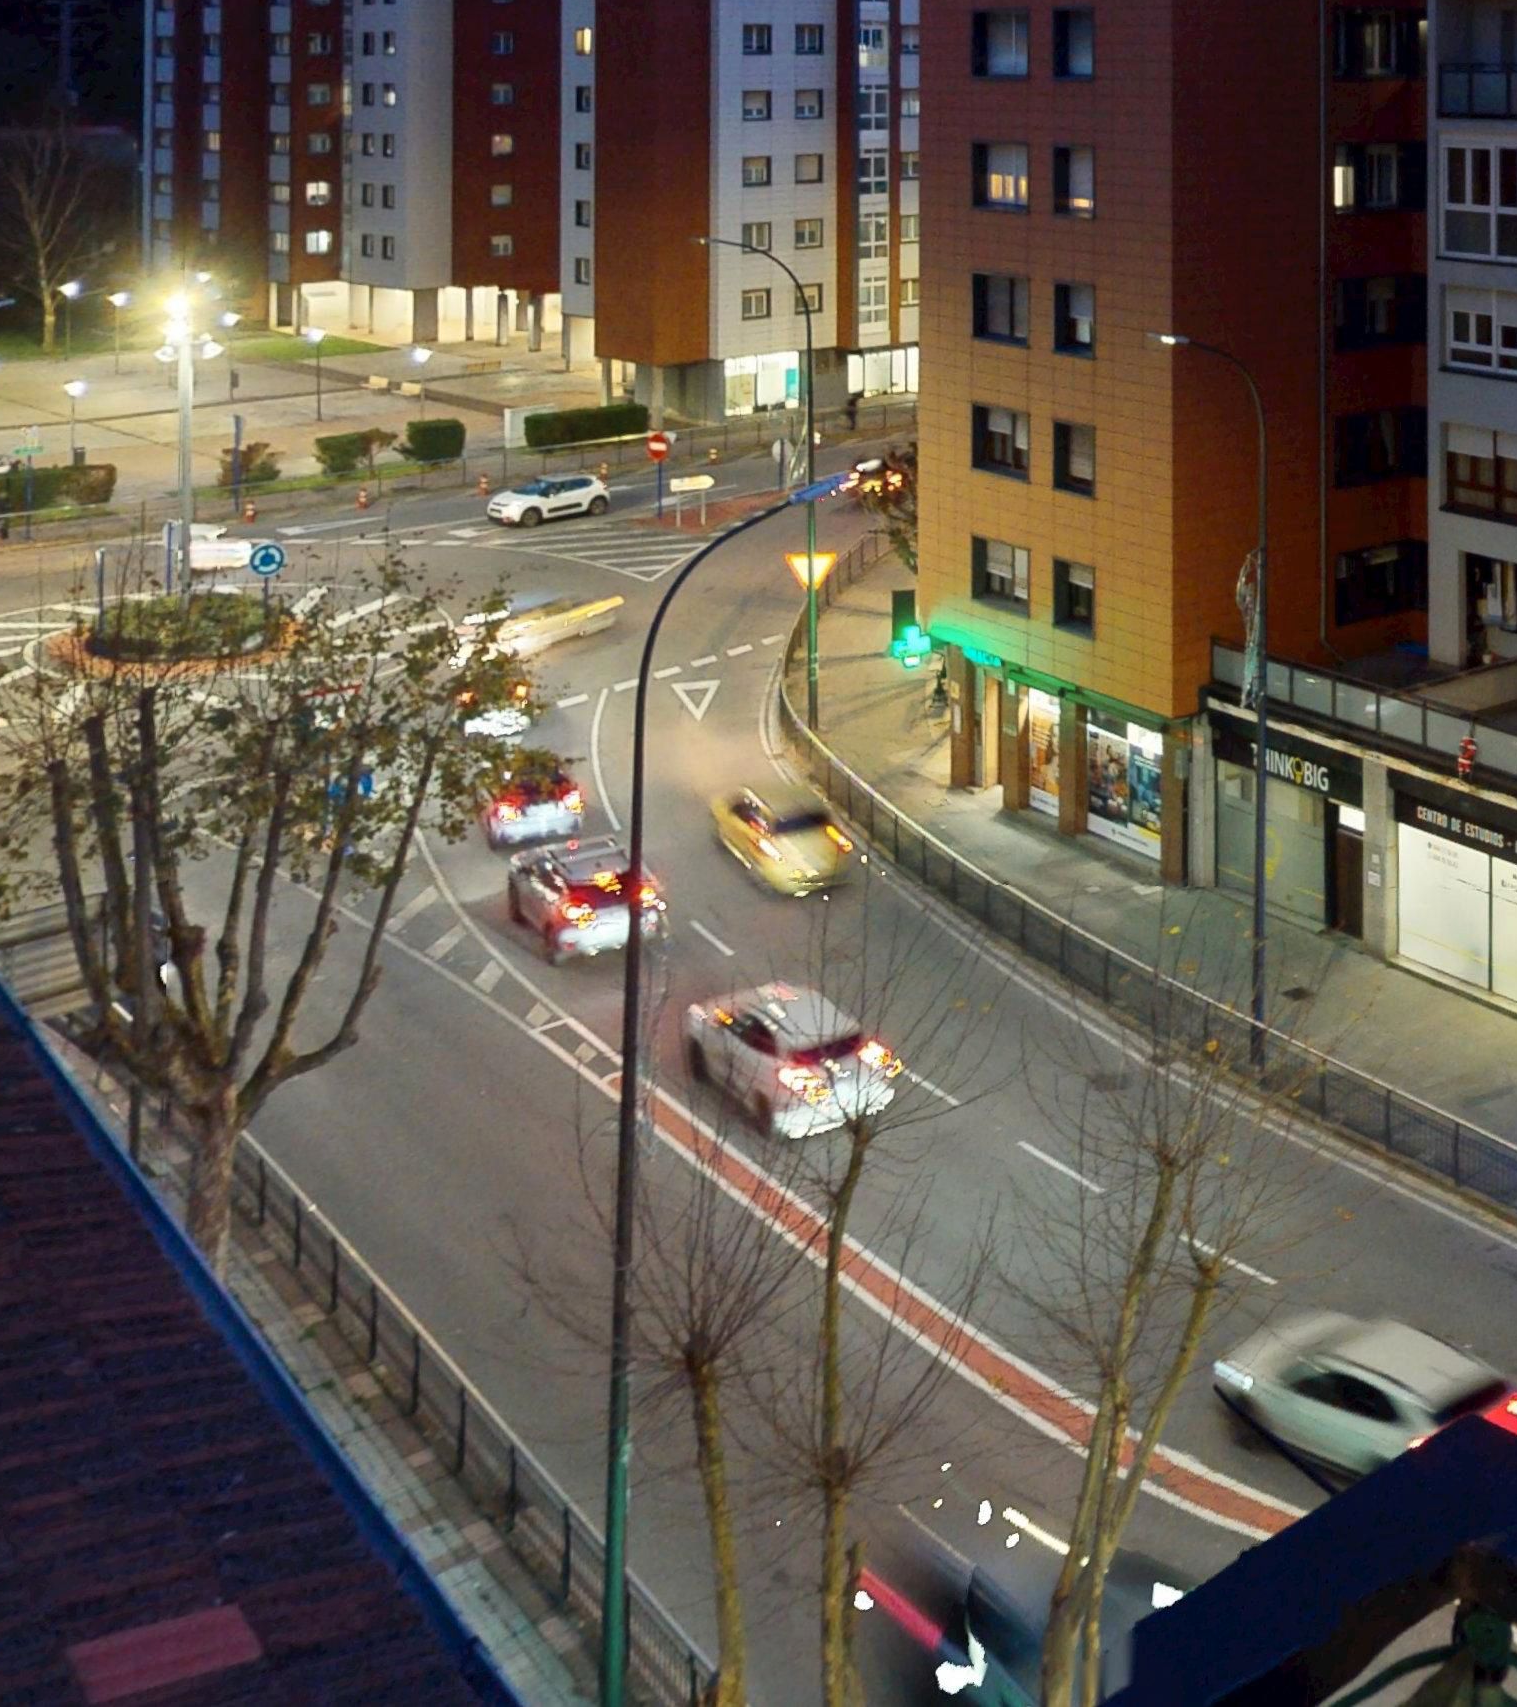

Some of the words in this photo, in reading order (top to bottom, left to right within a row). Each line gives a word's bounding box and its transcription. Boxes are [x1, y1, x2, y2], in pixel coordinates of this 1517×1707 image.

[1304, 761, 1329, 791] BIG
[1416, 805, 1448, 829] CENTRO
[1450, 817, 1462, 833] DE
[1464, 823, 1505, 849] ESTUDIOS
